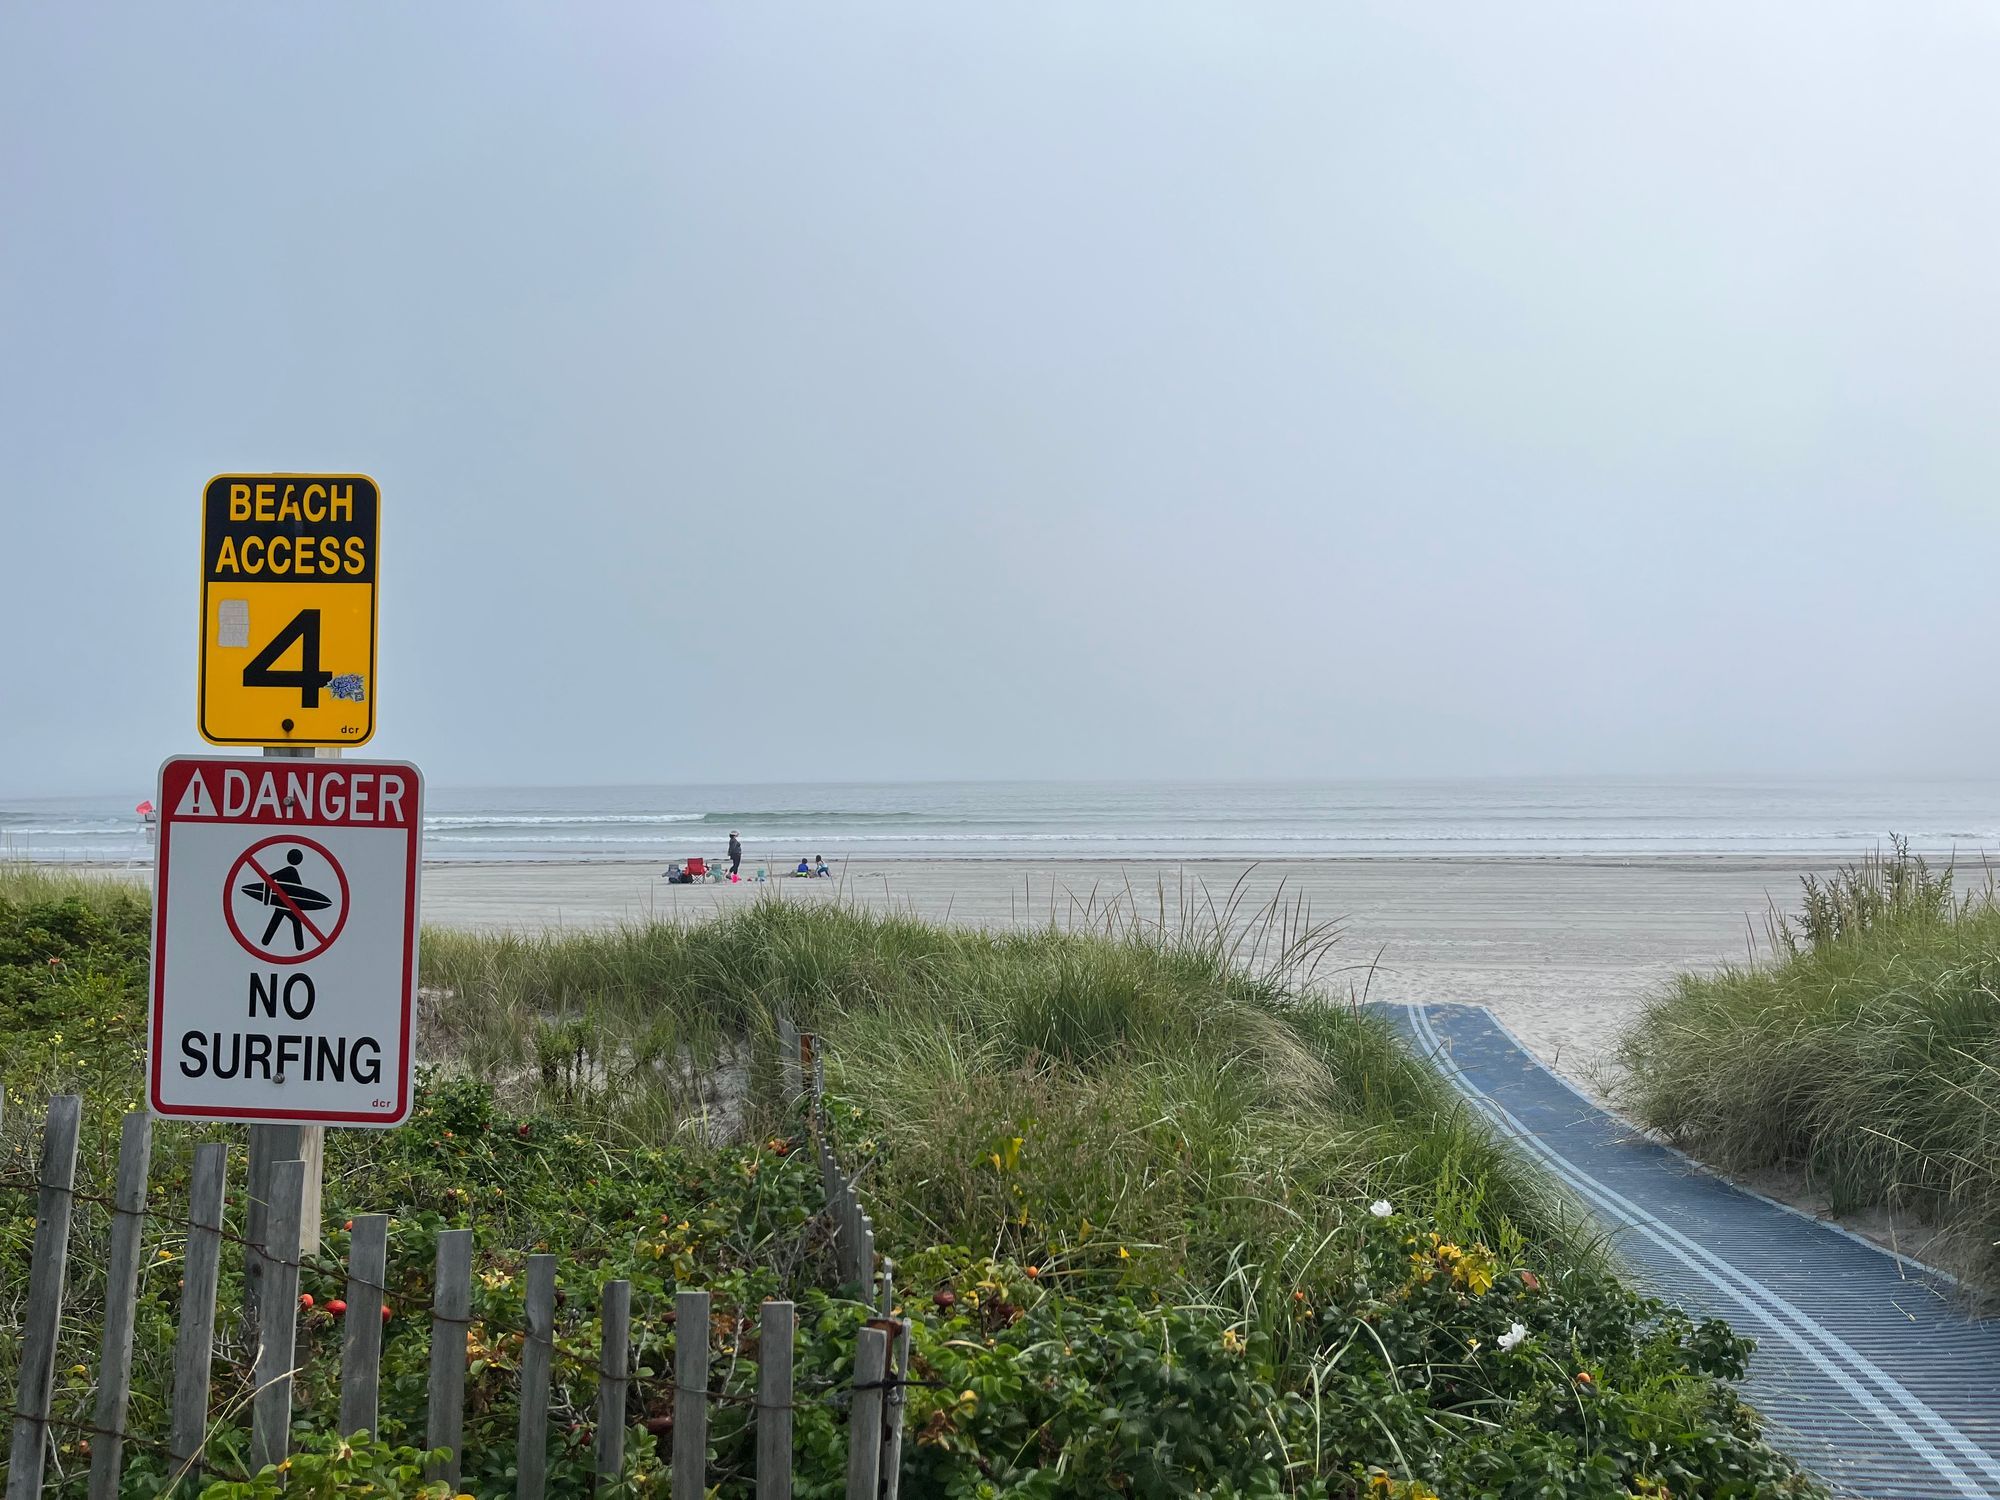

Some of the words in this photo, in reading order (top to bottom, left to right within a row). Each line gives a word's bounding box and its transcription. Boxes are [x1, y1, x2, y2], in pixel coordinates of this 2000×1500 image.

[229, 483, 354, 522] BEACH
[215, 535, 365, 575] ACCESS
[242, 608, 333, 708] 4
[341, 725, 359, 734] dcr
[222, 768, 406, 823] DANGER
[248, 972, 316, 1020] NO
[179, 1030, 382, 1084] SURFING
[372, 1098, 391, 1108] dcr
